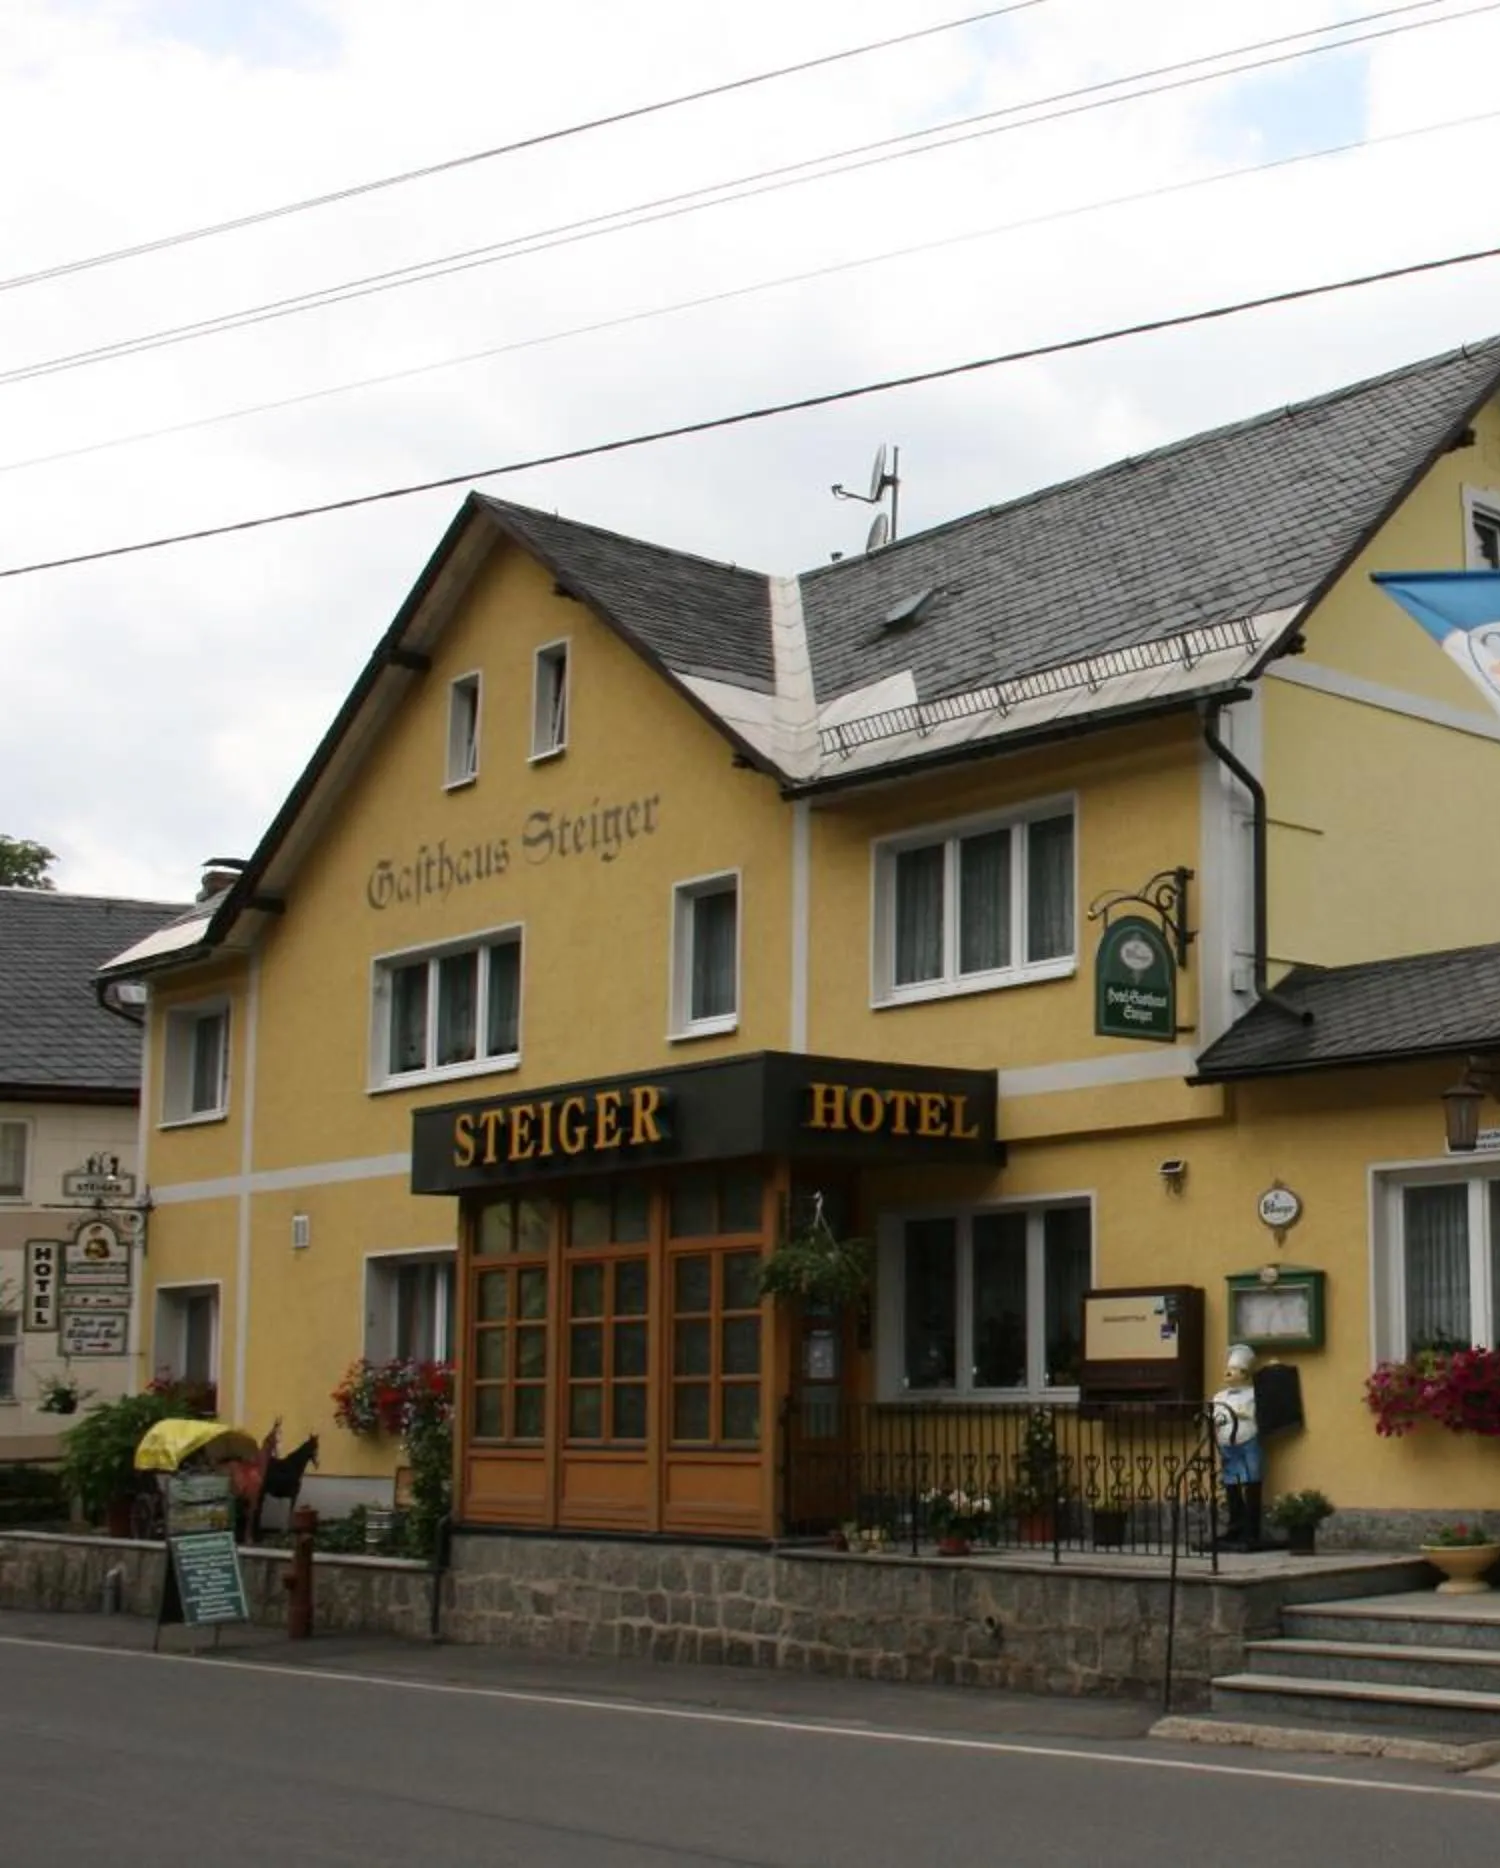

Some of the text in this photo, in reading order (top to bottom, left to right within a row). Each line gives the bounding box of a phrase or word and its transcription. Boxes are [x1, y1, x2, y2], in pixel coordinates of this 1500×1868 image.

[366, 794, 661, 910] Gasthaus Steiger
[452, 1084, 663, 1168] STEIGER
[808, 1082, 980, 1140] HOTEL
[33, 1247, 53, 1325] HOTEL
